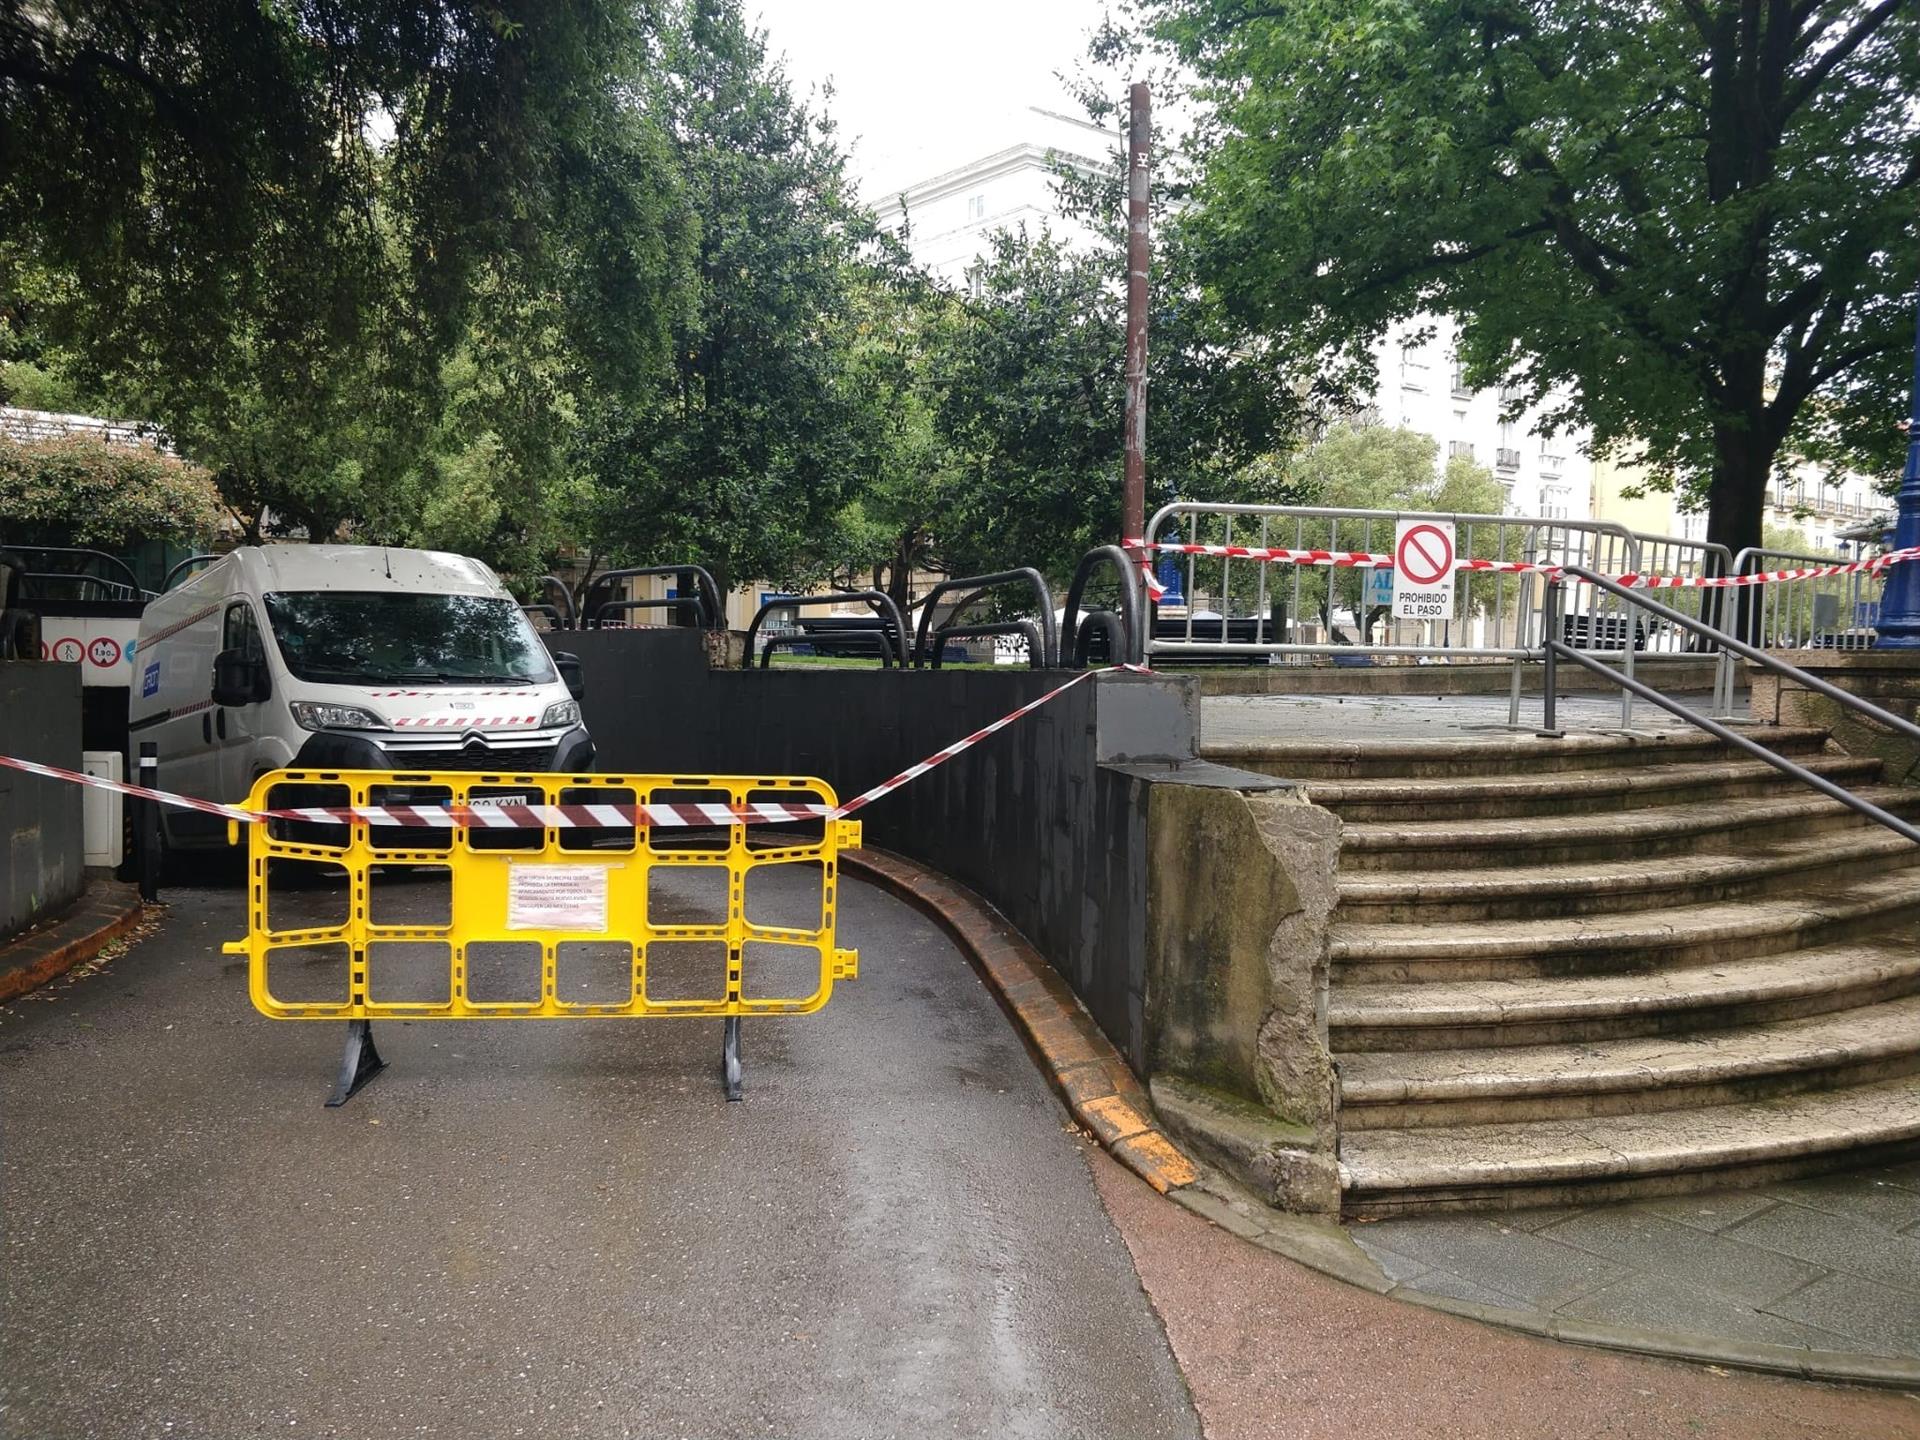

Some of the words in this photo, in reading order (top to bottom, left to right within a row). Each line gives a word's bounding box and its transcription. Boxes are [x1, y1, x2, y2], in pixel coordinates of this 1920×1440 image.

[1399, 592, 1447, 604] PROHIBIDO
[1403, 604, 1415, 615] EL
[1417, 605, 1442, 616] PASO
